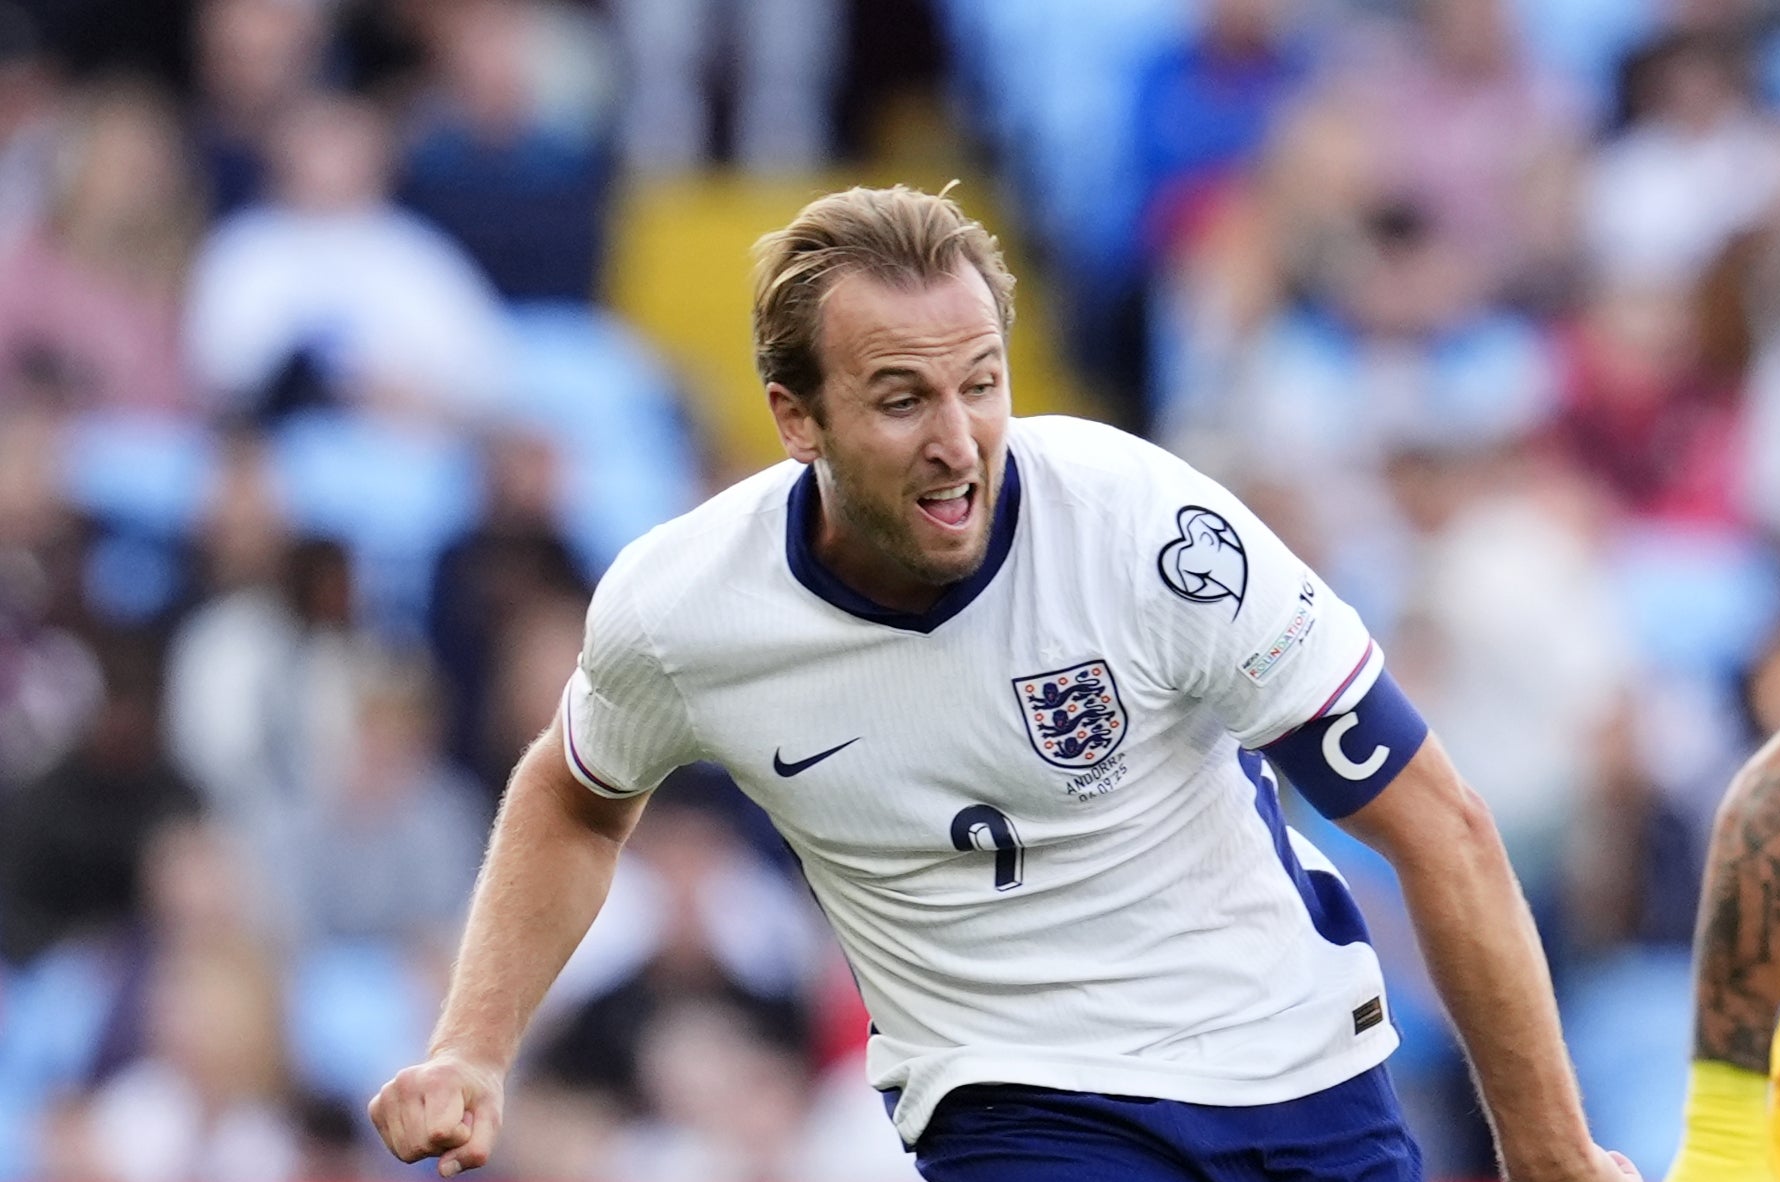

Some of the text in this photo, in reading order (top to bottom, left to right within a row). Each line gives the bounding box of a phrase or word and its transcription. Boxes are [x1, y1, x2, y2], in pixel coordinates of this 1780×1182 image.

[1321, 710, 1391, 781] C
[1078, 762, 1129, 803] 009.25
[949, 803, 1025, 892] 9
